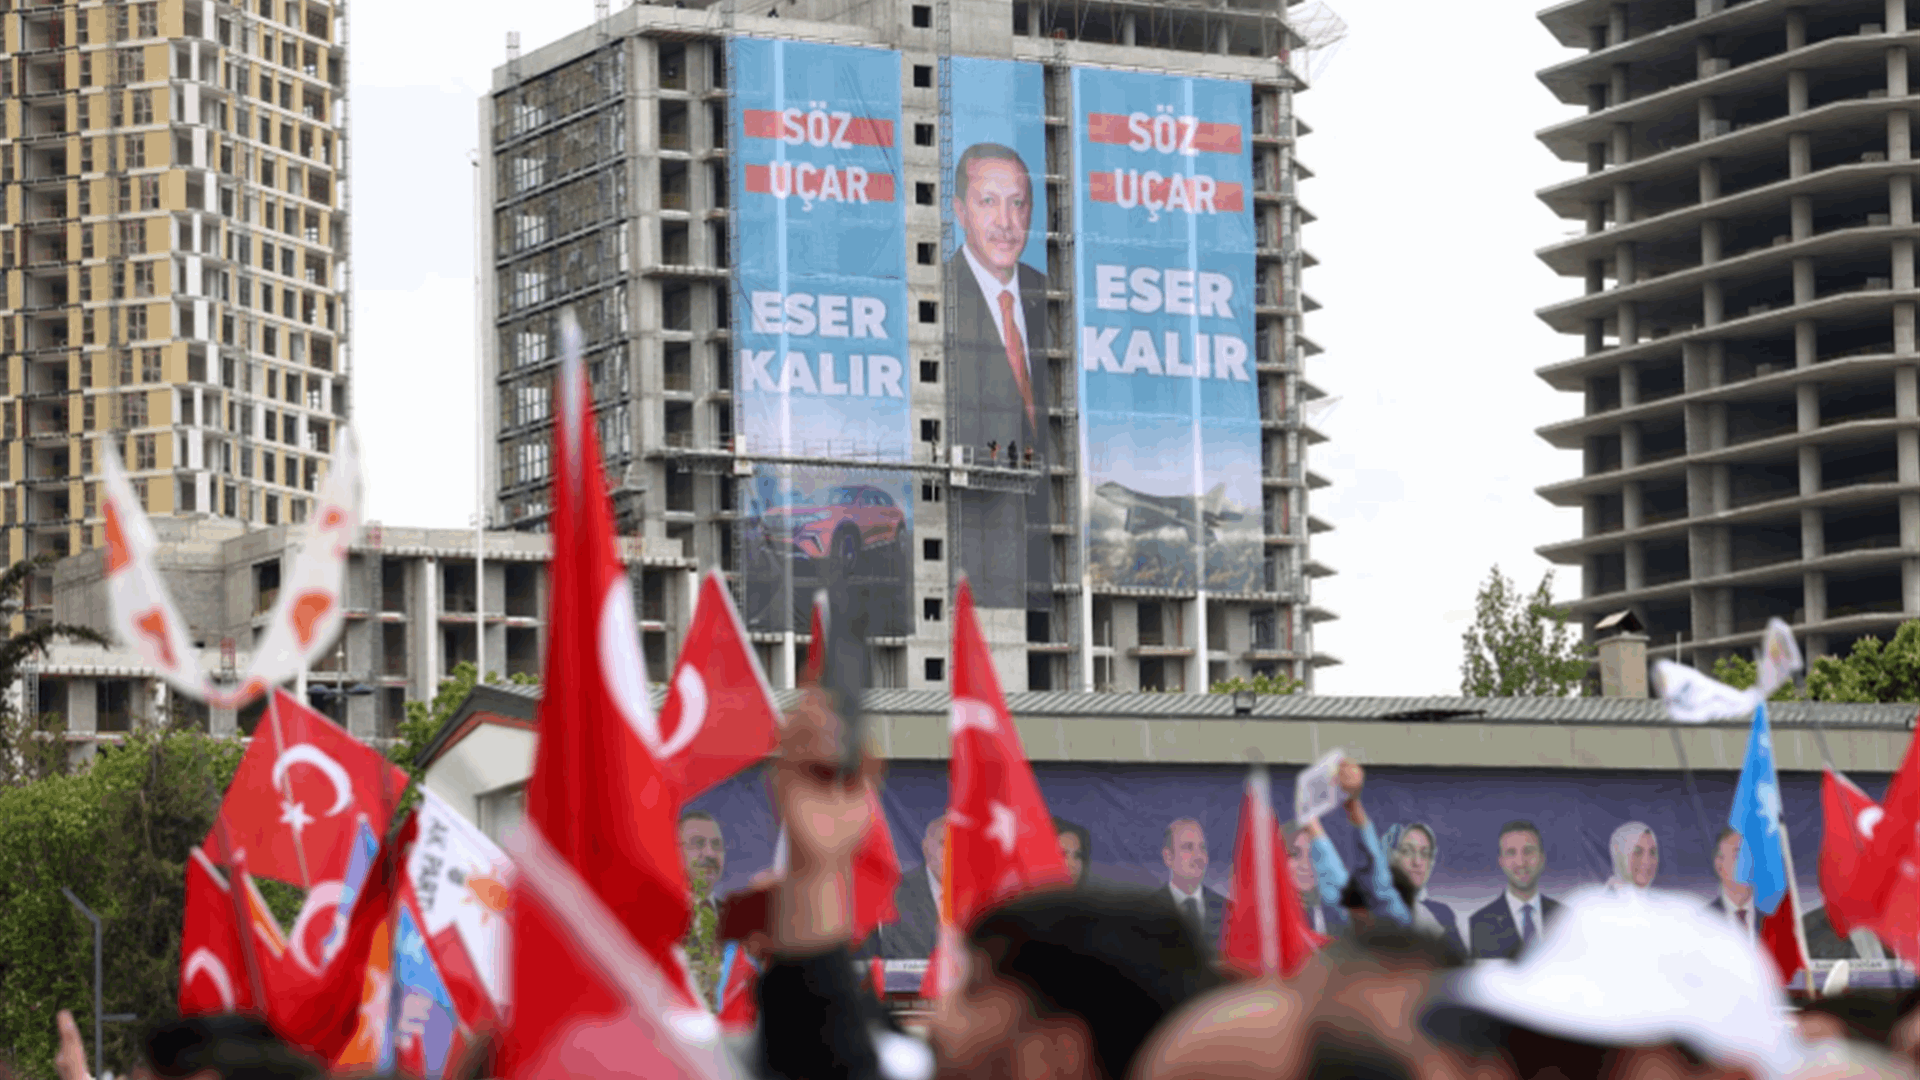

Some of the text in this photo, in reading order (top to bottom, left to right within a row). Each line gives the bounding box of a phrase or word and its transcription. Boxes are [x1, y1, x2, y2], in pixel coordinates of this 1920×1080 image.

[782, 101, 852, 149] SÖZ
[1129, 104, 1199, 157] SÖZ
[769, 161, 868, 211] UÇAR
[1115, 168, 1216, 222] UÇAR
[752, 291, 888, 339] ESER
[1096, 264, 1235, 319] ESER
[740, 348, 904, 398] KALIR
[1082, 326, 1250, 381] KALIR
